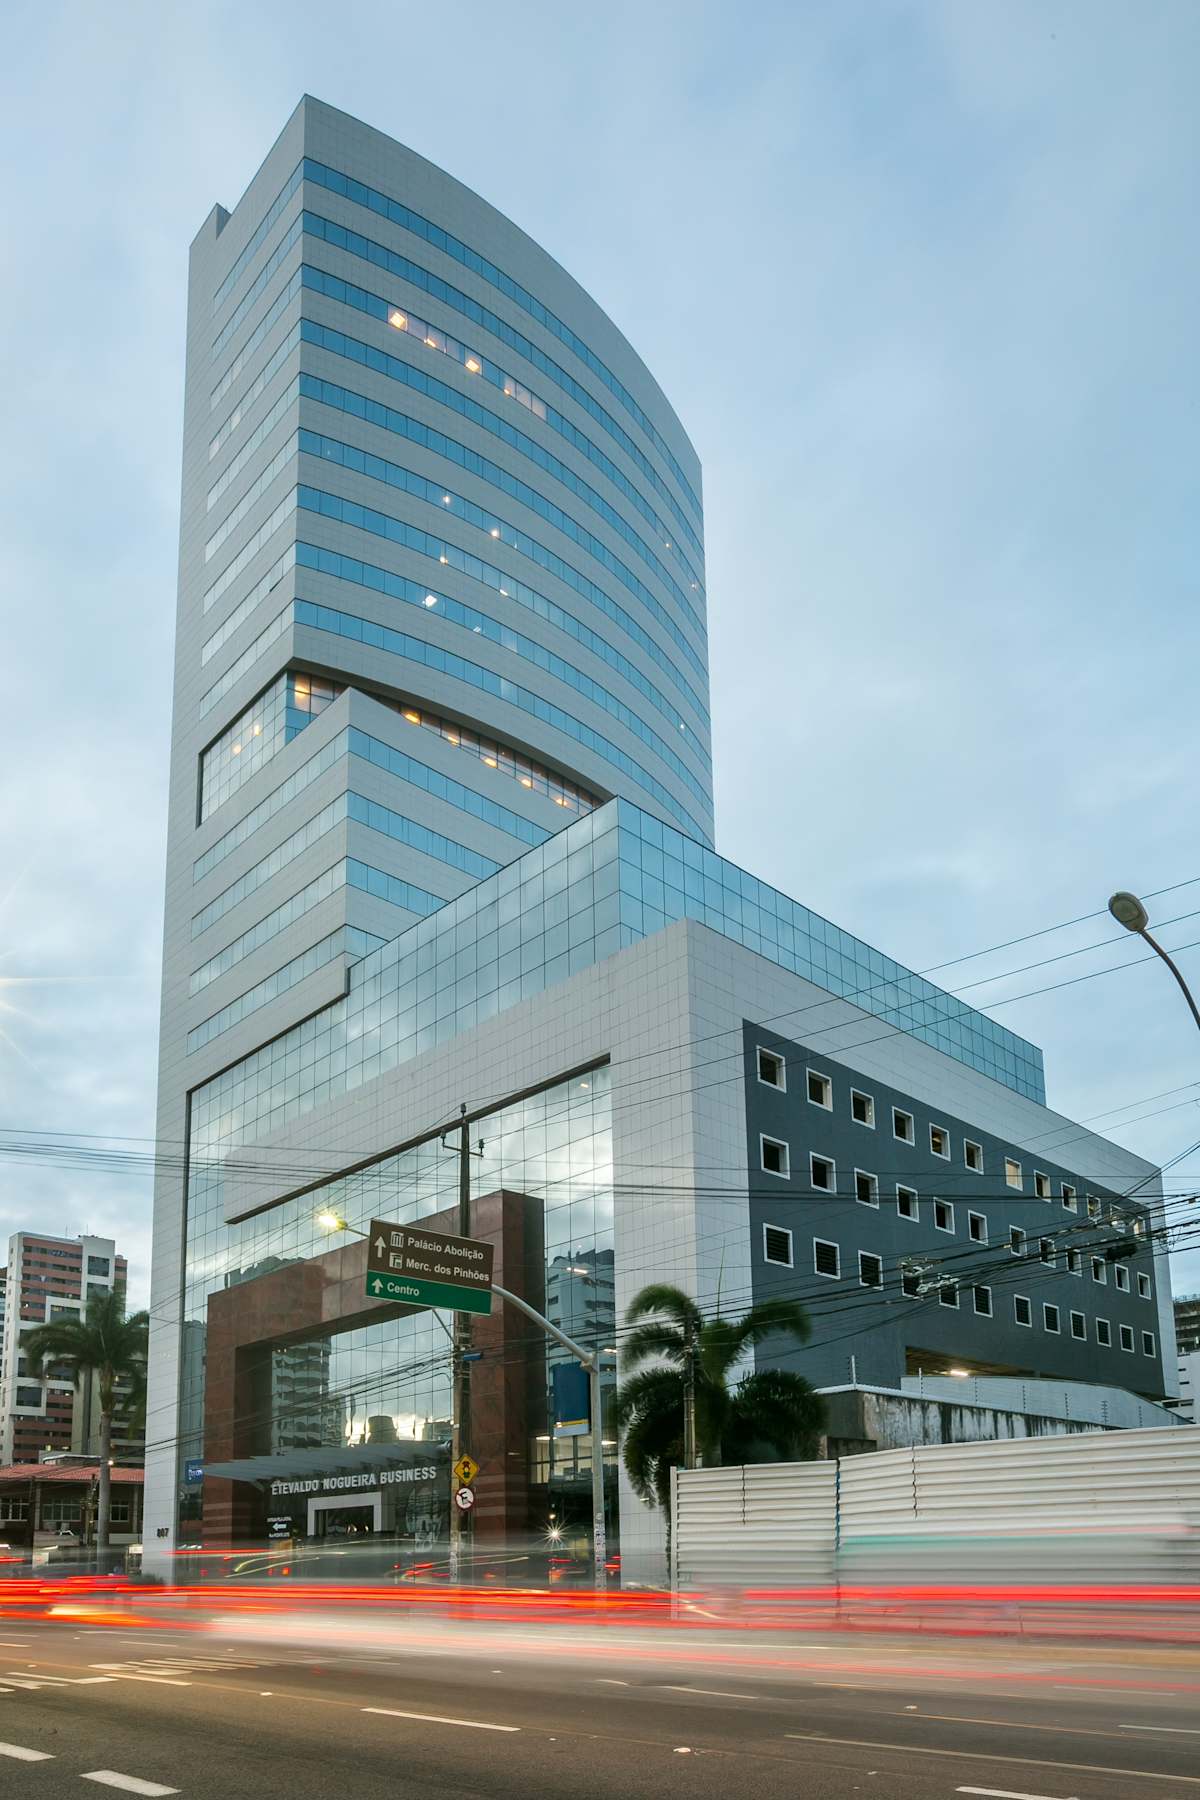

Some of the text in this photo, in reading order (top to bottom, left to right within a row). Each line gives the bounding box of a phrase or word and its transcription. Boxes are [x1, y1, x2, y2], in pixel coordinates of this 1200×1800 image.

[407, 1237, 484, 1260] Palácio Abolição
[406, 1258, 490, 1281] Merc. dos Pinhões
[387, 1282, 420, 1296] Centro
[271, 1466, 437, 1496] ETEVALDO NOGUEIRA BUSINESS
